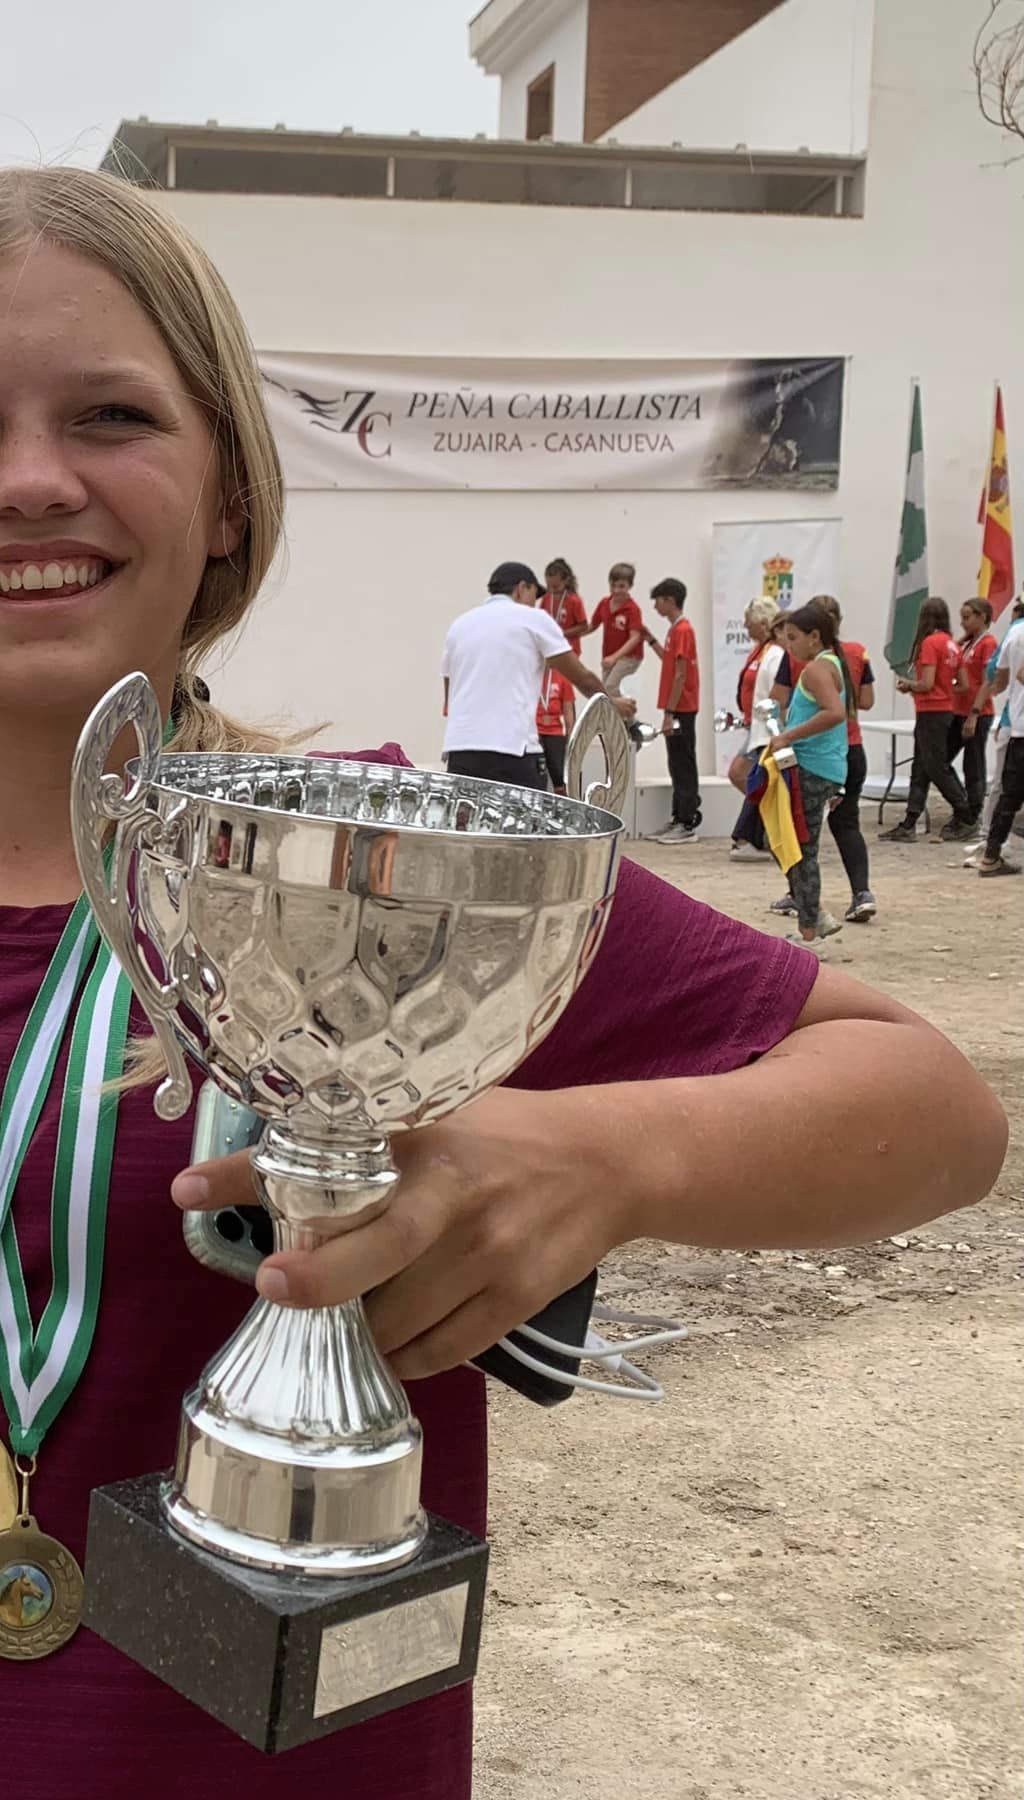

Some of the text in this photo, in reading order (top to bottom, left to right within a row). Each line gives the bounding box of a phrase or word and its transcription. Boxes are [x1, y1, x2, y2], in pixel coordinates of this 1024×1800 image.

[405, 386, 703, 421] PEÑA CABALLISTA
[432, 431, 523, 453] ZUJAIRA
[543, 432, 676, 453] CASANUEVA
[726, 632, 753, 645] PIN
